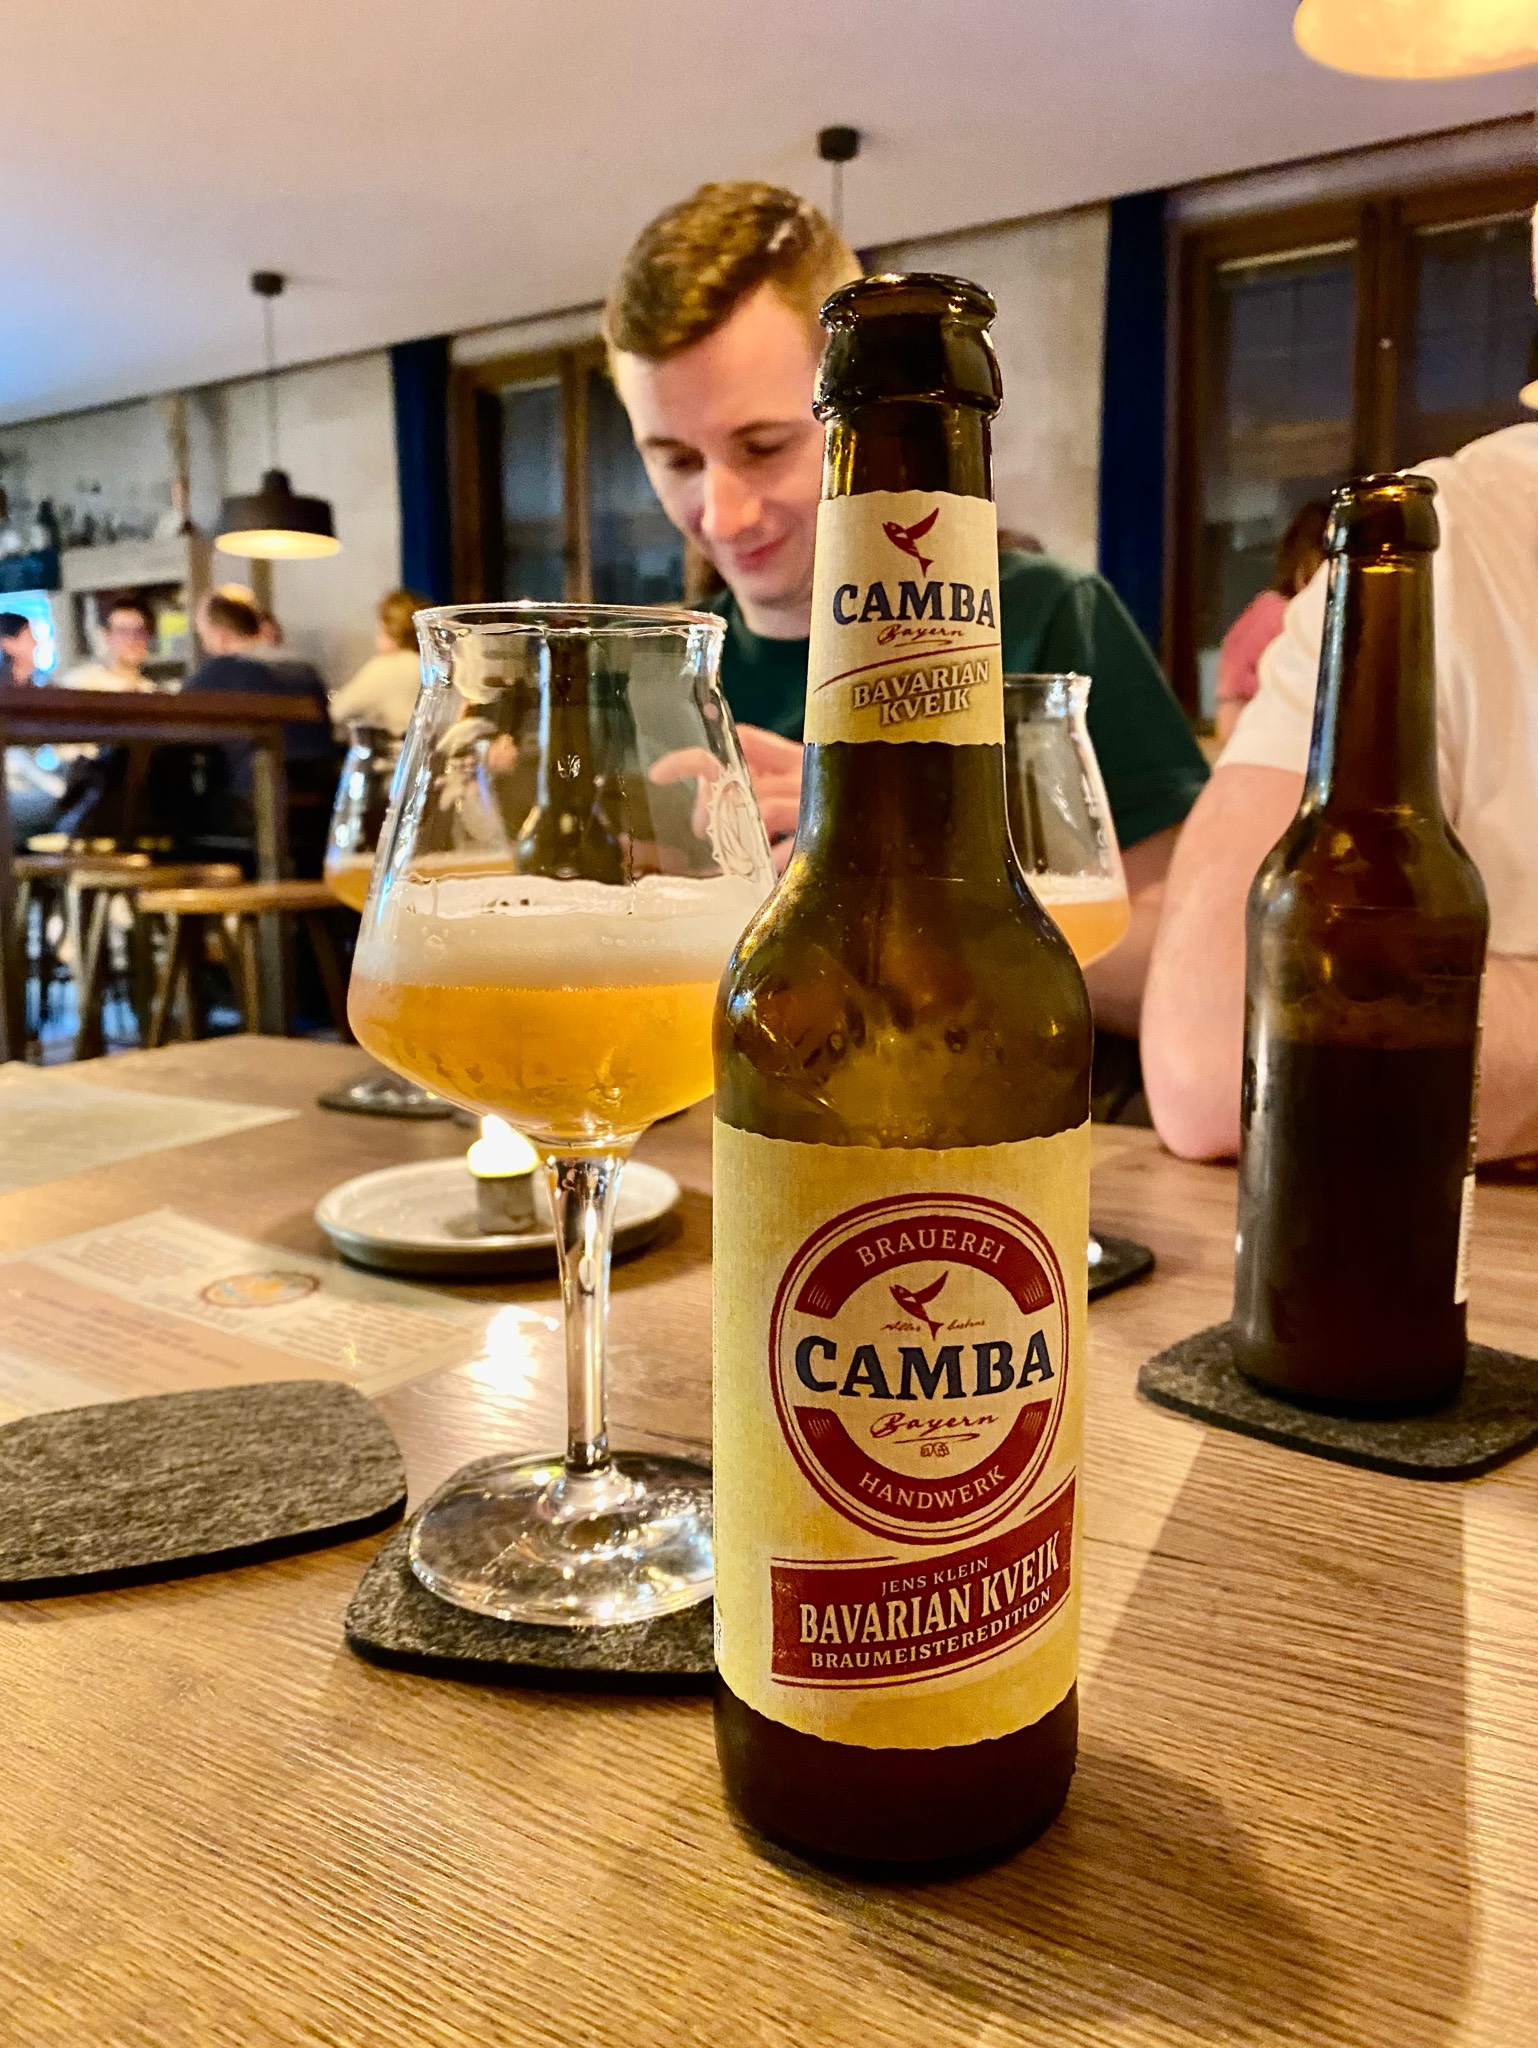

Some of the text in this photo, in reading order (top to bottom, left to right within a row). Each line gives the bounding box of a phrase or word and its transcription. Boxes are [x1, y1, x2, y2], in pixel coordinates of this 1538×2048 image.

[833, 581, 995, 629] CAMBA
[877, 624, 965, 645] Bayern
[853, 660, 989, 708] BAVARIAN
[880, 687, 972, 726] KVEIK
[855, 1228, 1006, 1267] BRAUEREI
[794, 1329, 1055, 1401] CAMBA
[869, 1411, 999, 1439] Bayern
[858, 1464, 1007, 1510] HANDWERK
[799, 1582, 971, 1645] BAVARIAN
[980, 1530, 1060, 1618] KVEIK
[881, 1556, 989, 1597] JENS KLEIN
[811, 1586, 1051, 1669] BRAUMEISTEREDITION
